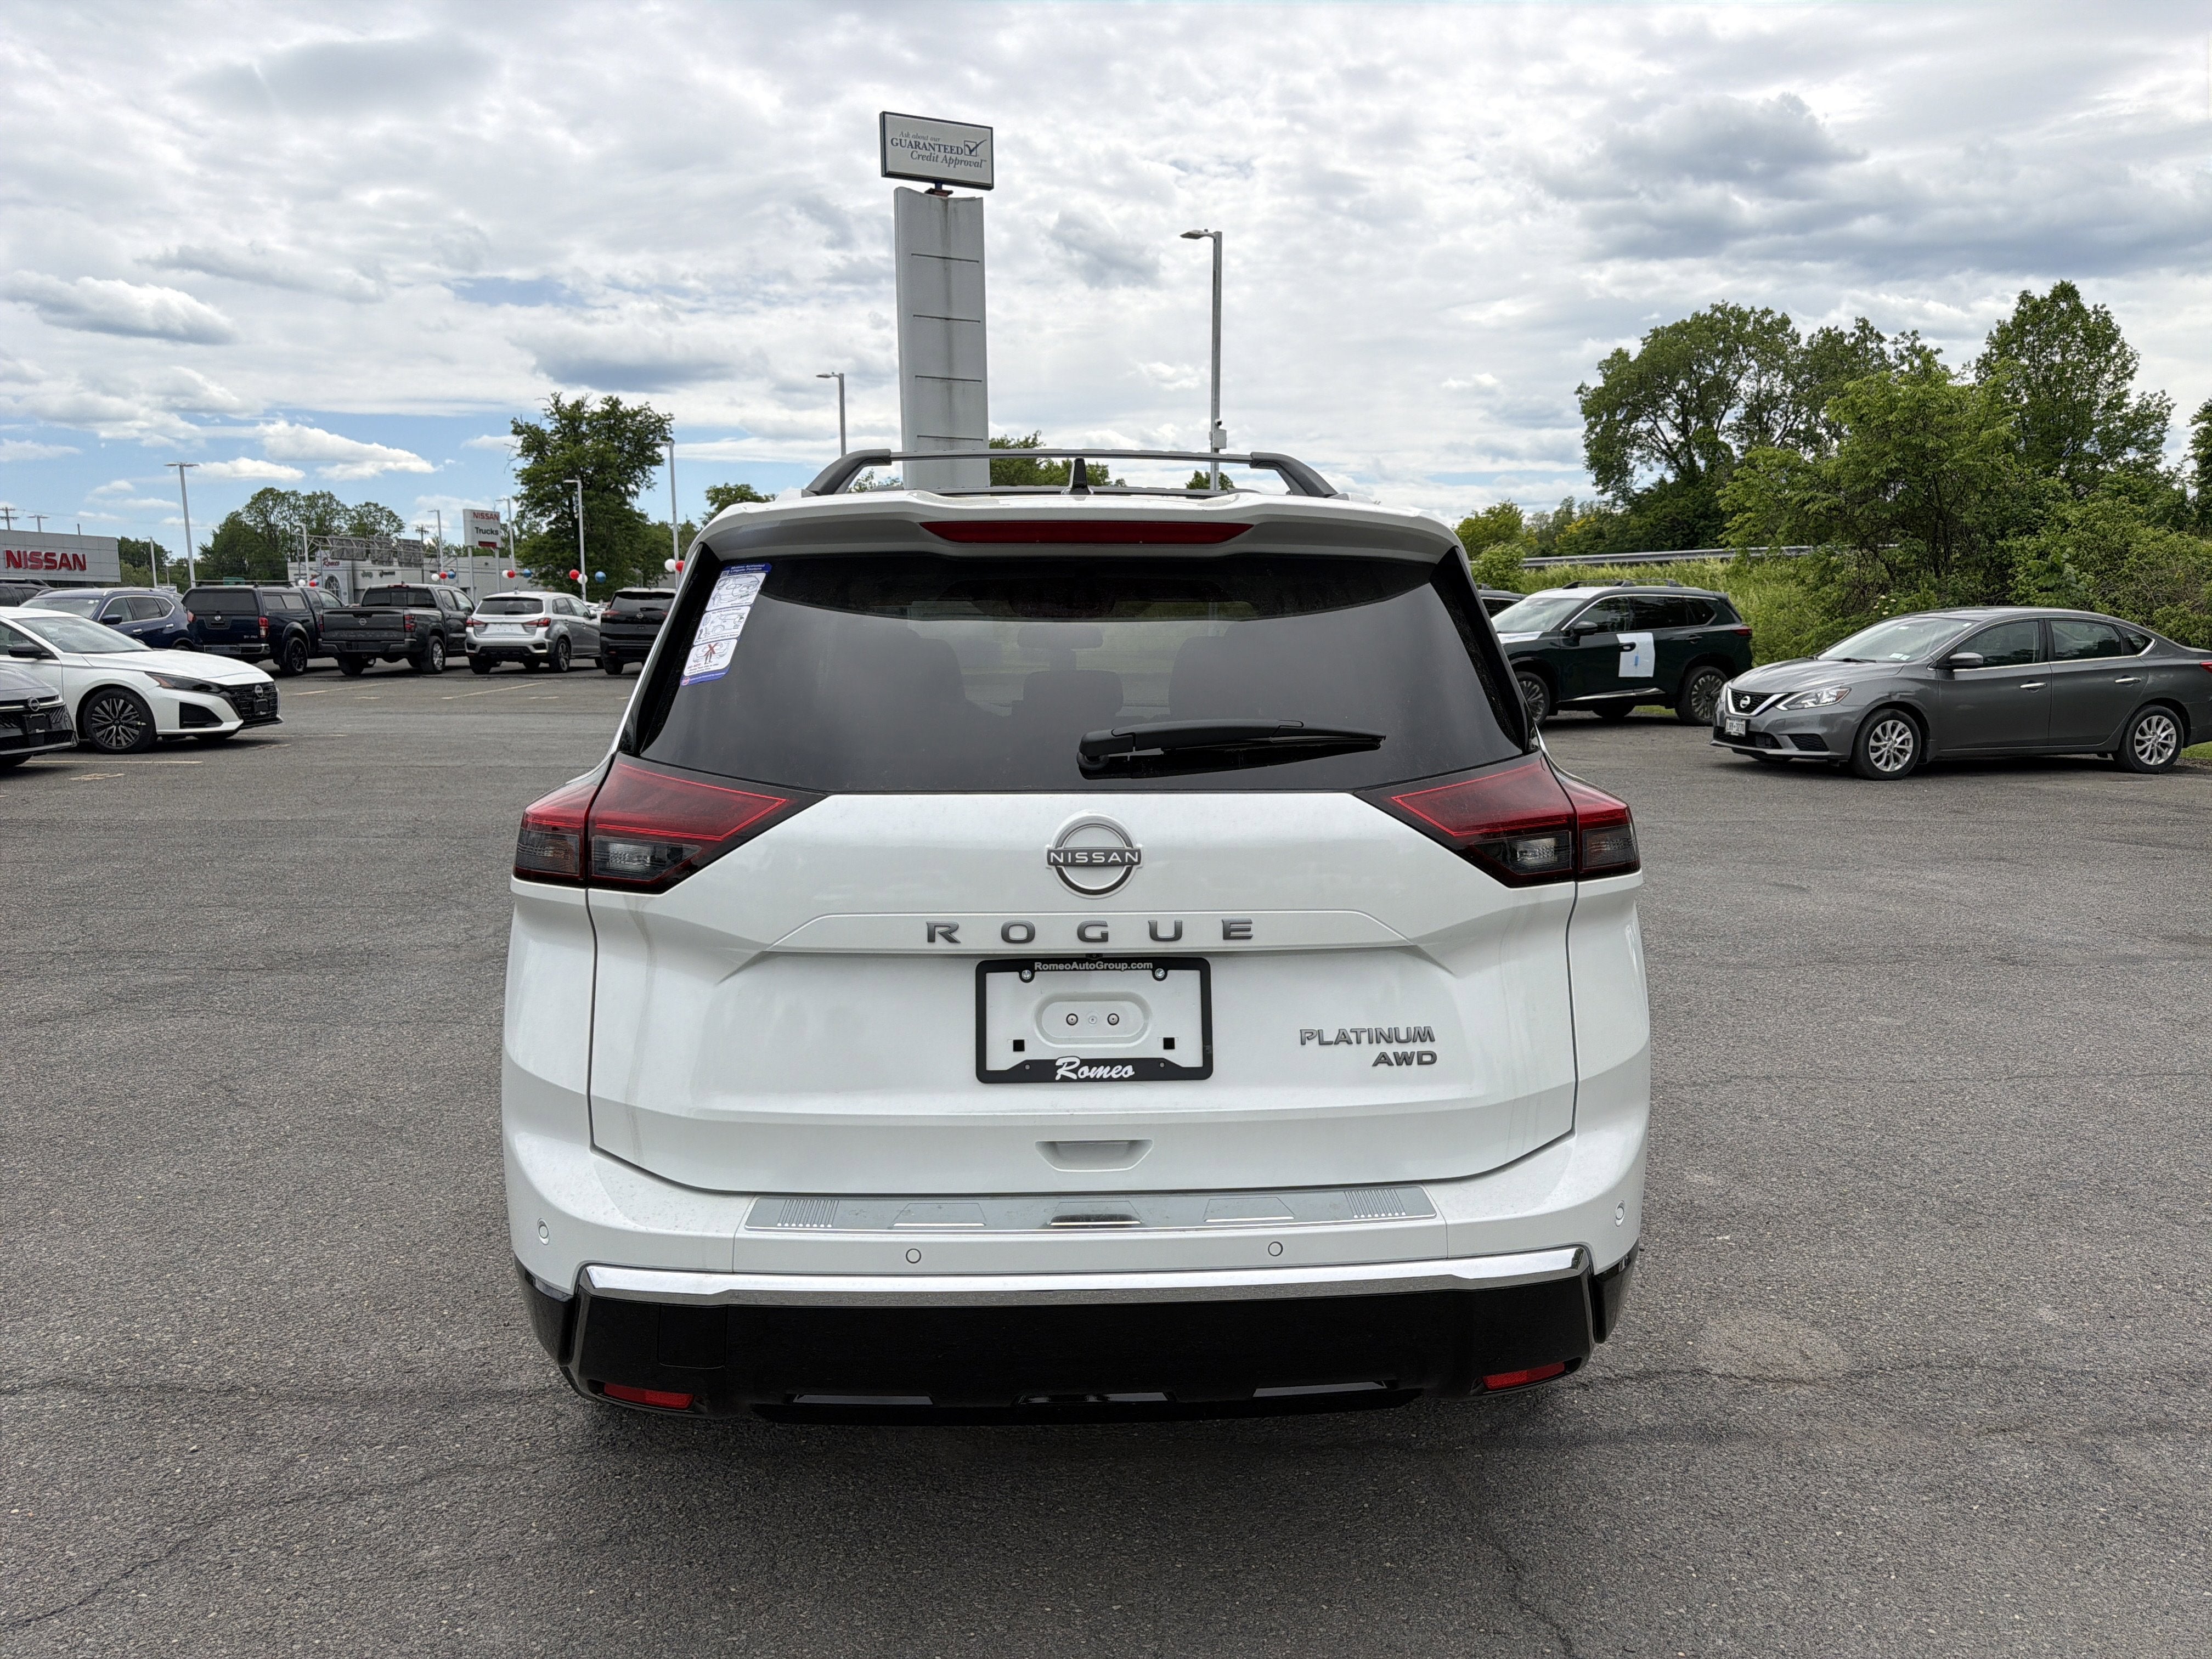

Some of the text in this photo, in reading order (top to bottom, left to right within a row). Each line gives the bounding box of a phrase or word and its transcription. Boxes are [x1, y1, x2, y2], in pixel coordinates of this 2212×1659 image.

[890, 138, 963, 155] GUARANTEED
[910, 150, 983, 168] Credit Approval
[473, 511, 499, 521] NISSAN
[475, 527, 499, 535] Trucks
[4, 550, 87, 571] NISSAN
[1050, 851, 1138, 863] NISSAN
[926, 918, 1254, 944] ROGUE
[1034, 961, 1153, 971] RomeoAutoGroup.com
[1300, 1026, 1436, 1046] PLATINUM
[1372, 1050, 1437, 1066] AWD
[1055, 1056, 1135, 1081] Romeo
